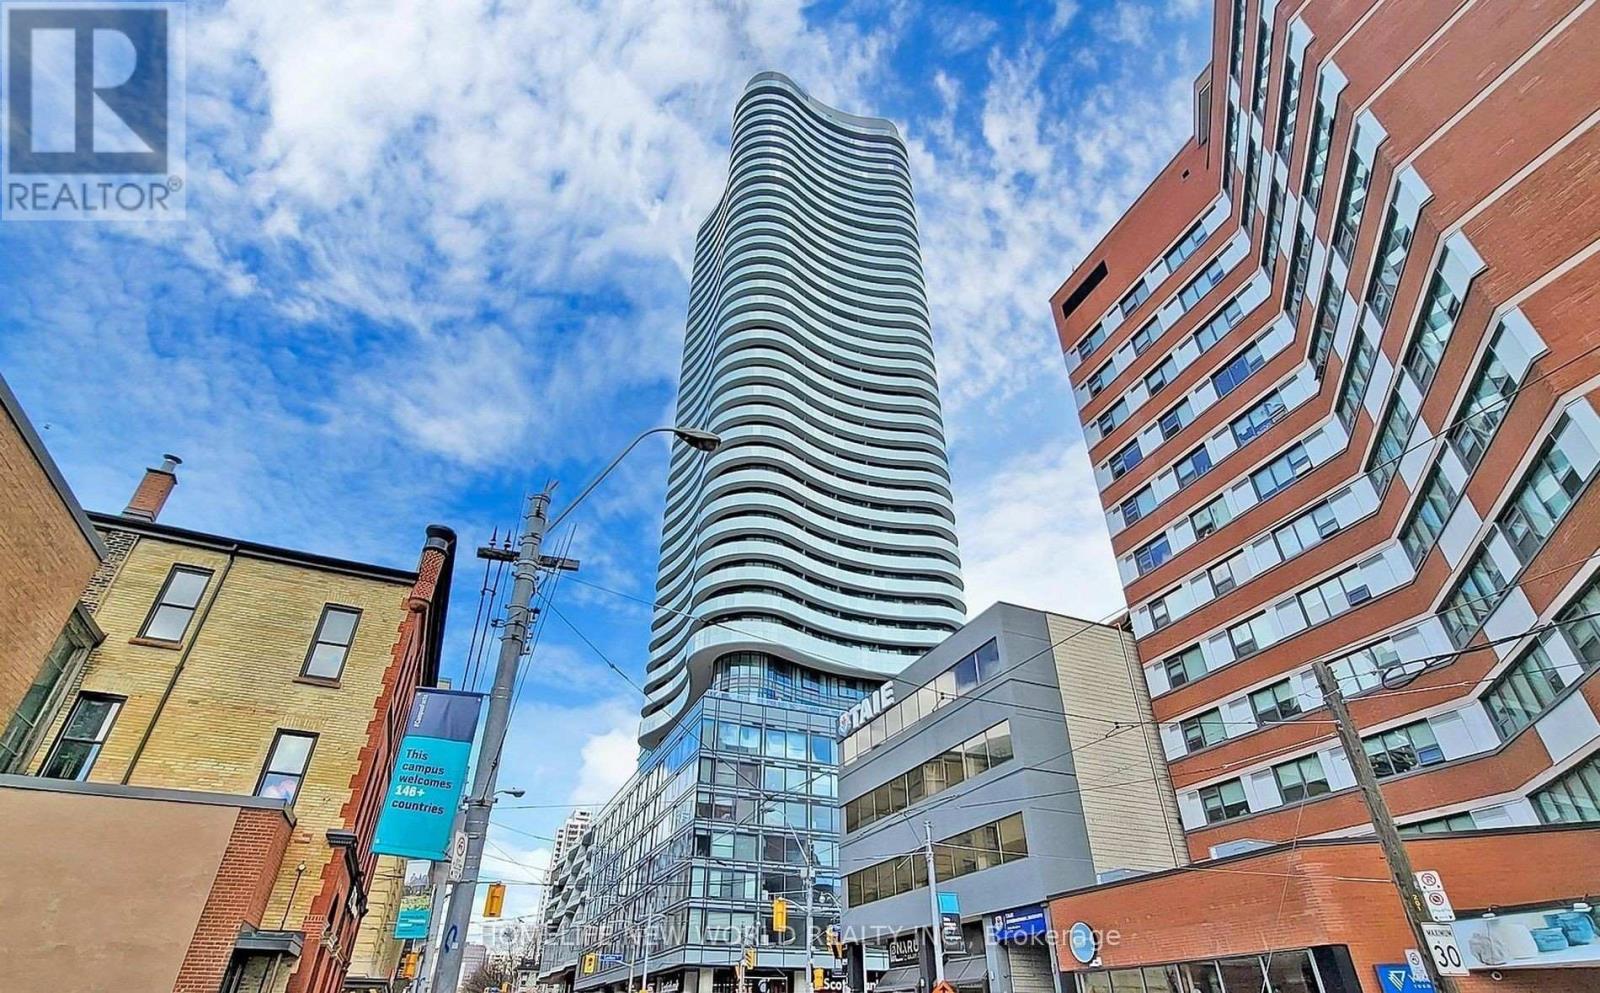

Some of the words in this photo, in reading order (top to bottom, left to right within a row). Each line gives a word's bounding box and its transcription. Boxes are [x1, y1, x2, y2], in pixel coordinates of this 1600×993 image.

[406, 748, 429, 761] This
[402, 763, 445, 776] campus
[399, 774, 453, 790] welcomes
[394, 784, 425, 797] 146+
[391, 800, 445, 815] countries
[1434, 945, 1461, 968] 30
